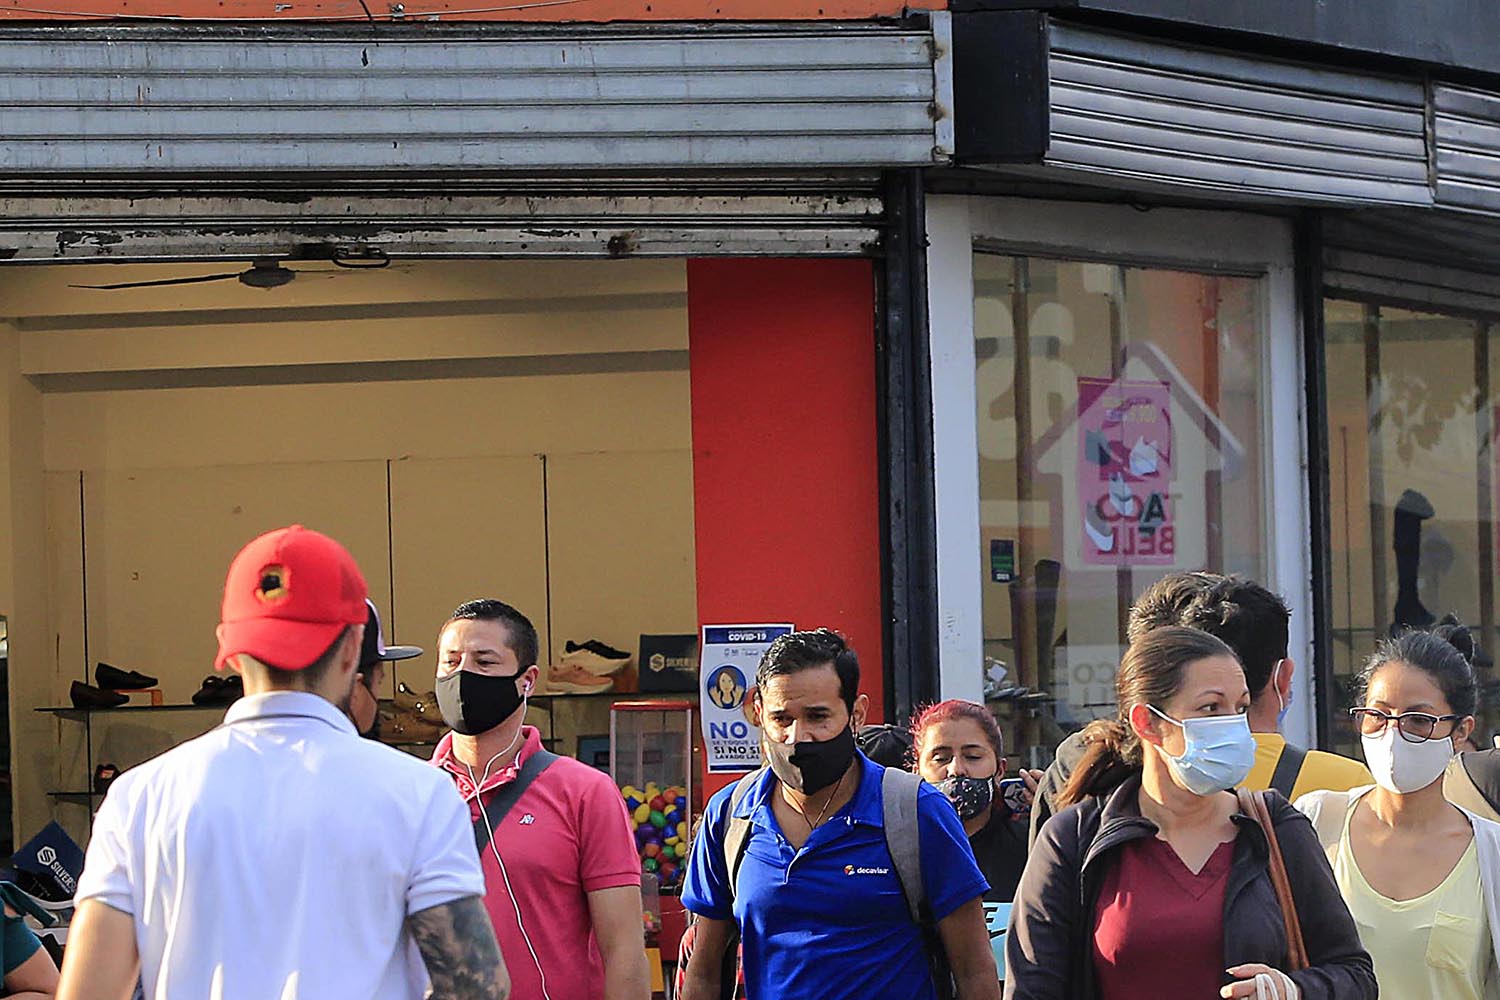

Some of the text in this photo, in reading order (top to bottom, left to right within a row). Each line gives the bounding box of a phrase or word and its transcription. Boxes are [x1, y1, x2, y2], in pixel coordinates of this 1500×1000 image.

[728, 633, 767, 642] COVID-19
[709, 721, 748, 740] NO
[714, 746, 725, 754] SI
[729, 746, 747, 754] NO
